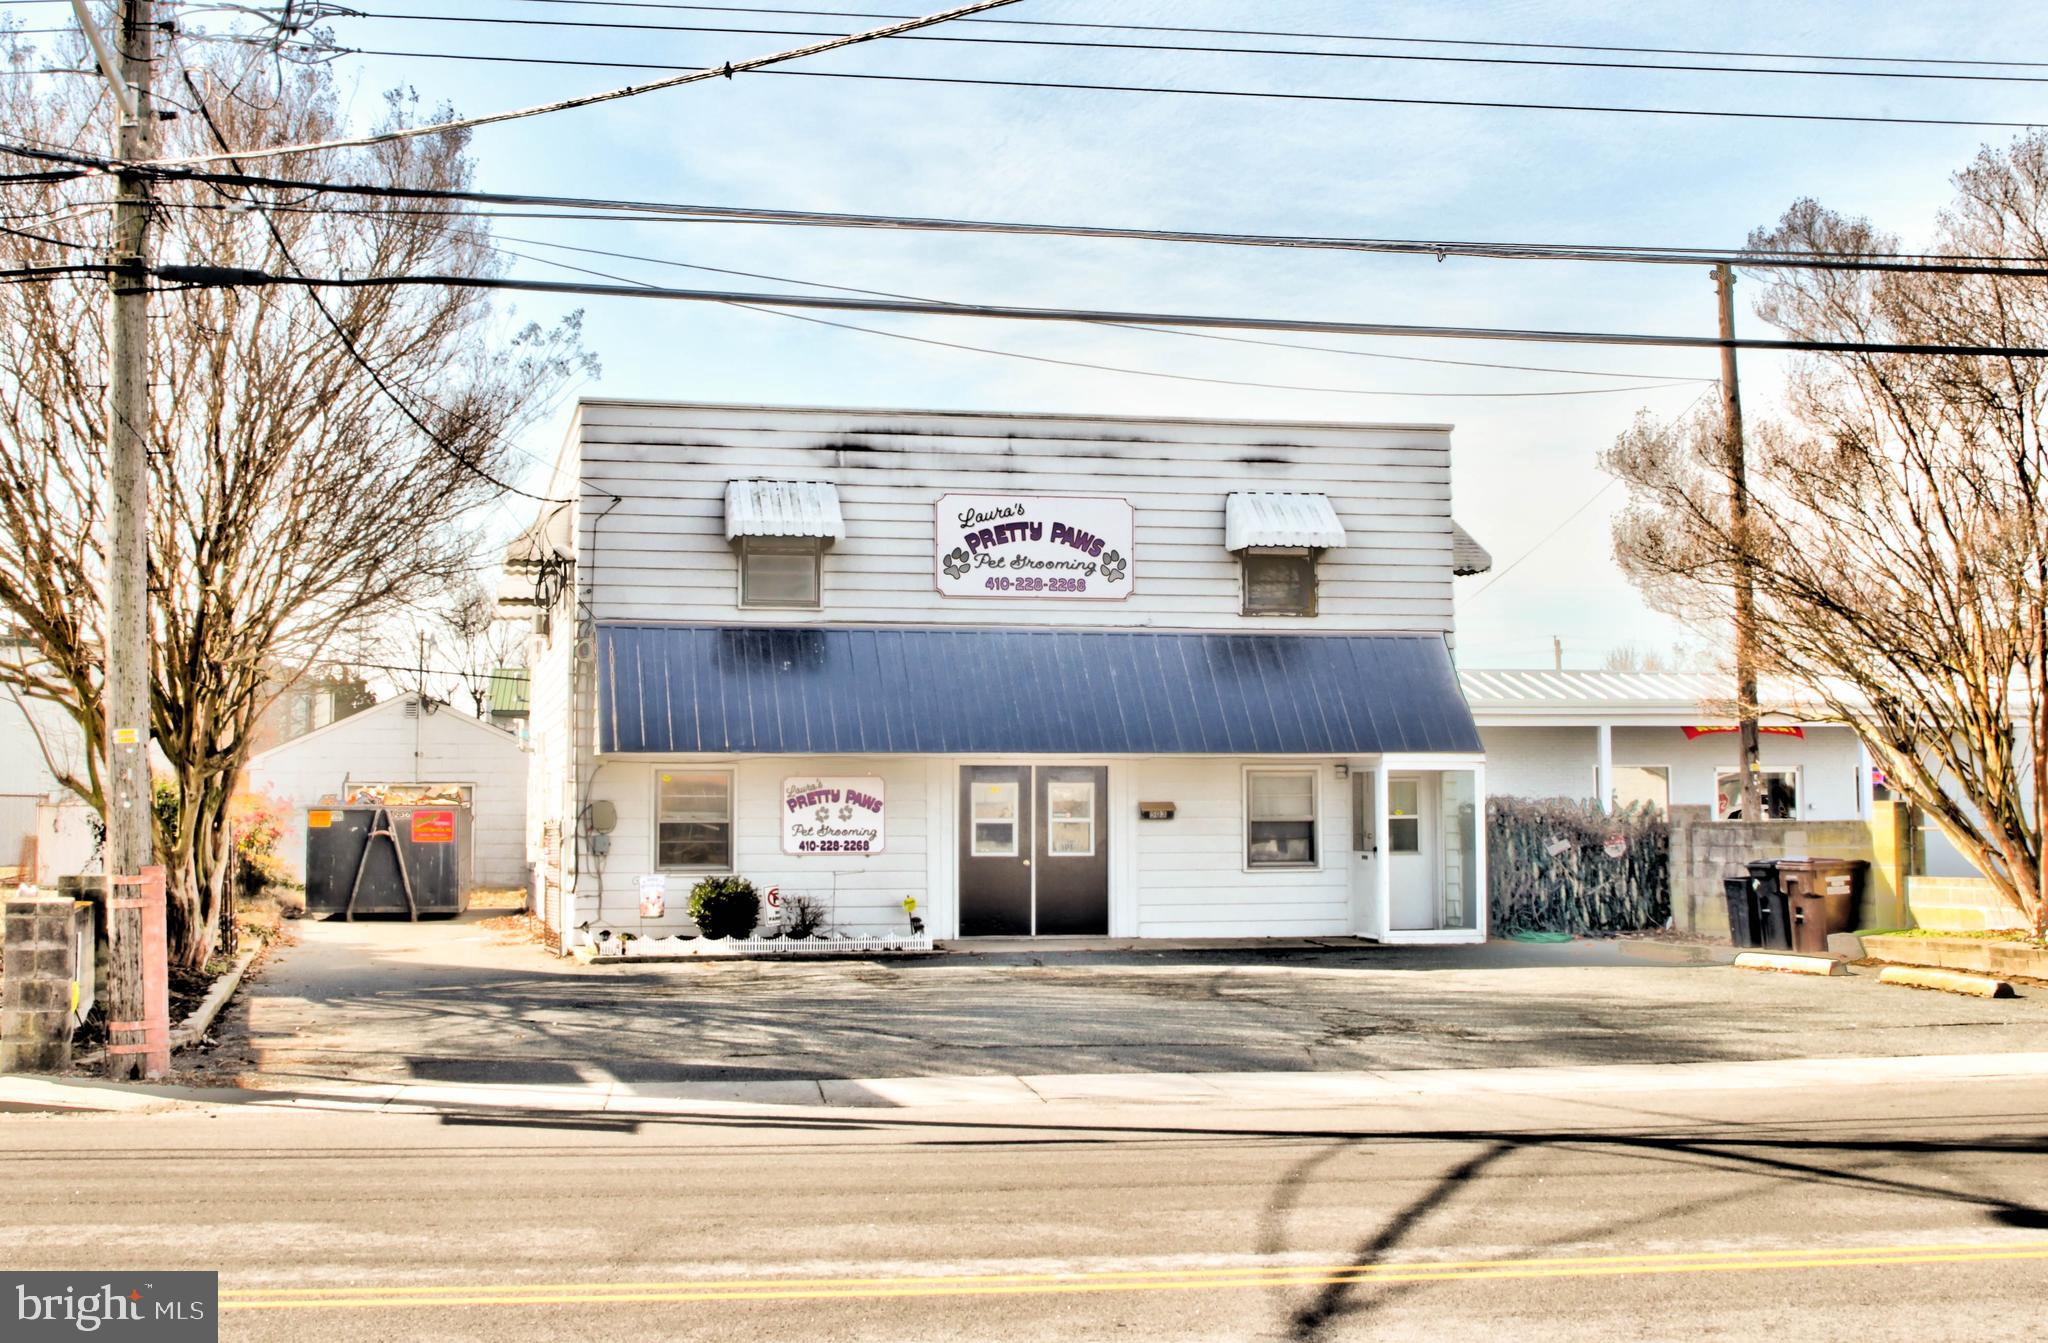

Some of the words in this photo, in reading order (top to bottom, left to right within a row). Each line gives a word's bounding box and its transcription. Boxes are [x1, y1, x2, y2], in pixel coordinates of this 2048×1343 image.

[958, 503, 1025, 529] Laura's
[964, 521, 1043, 555] PRETTY
[1050, 522, 1106, 557] PAWS
[974, 553, 1006, 569] Pet
[1010, 554, 1097, 577] Grooming
[985, 576, 1087, 592] 410-228-2268
[786, 778, 823, 798] Laura's
[786, 789, 840, 813] PRETTY
[845, 789, 883, 813] PAWS
[792, 824, 814, 837] Pet
[817, 825, 877, 841] Grooming
[799, 840, 870, 851] 410-228-2268
